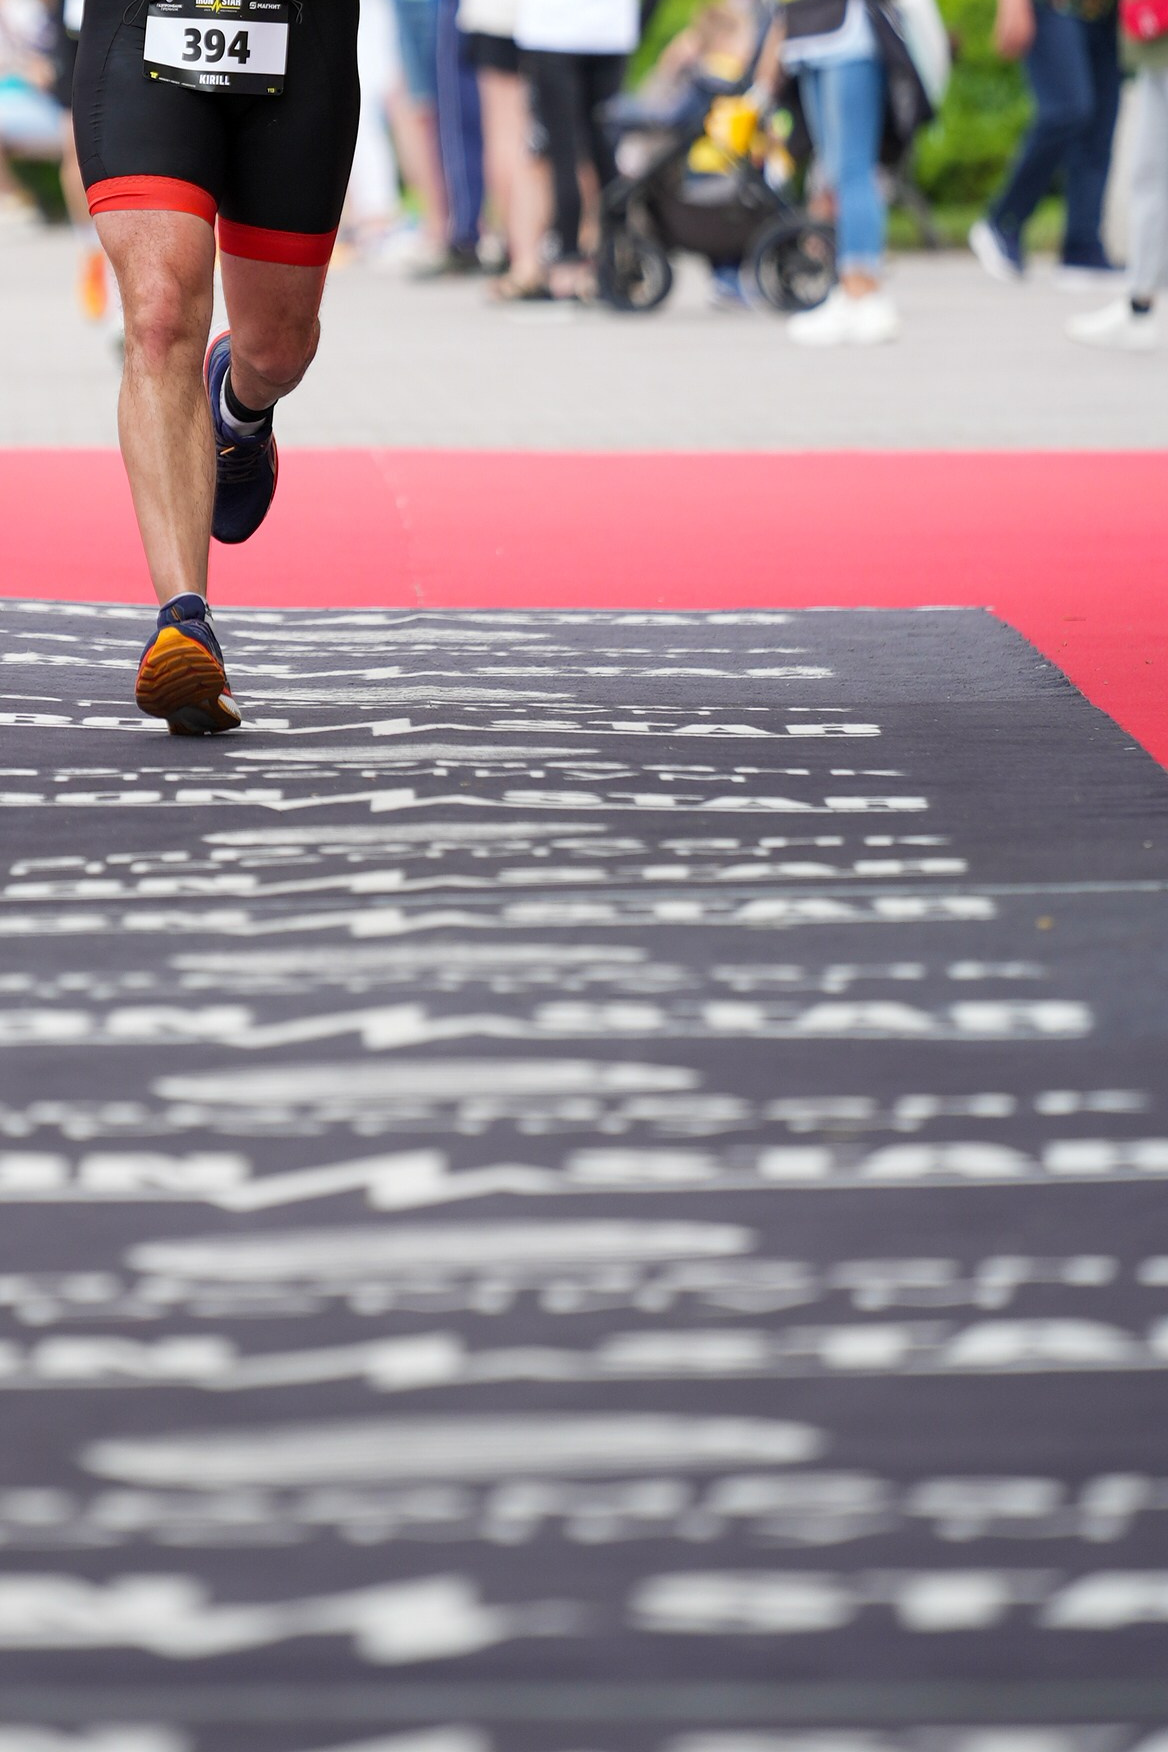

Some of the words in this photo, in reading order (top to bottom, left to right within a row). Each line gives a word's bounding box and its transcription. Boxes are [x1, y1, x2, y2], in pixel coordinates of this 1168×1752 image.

[181, 27, 251, 65] 394
[198, 74, 230, 86] KIRILL
[487, 719, 884, 735] STAR
[499, 790, 931, 810] STAR
